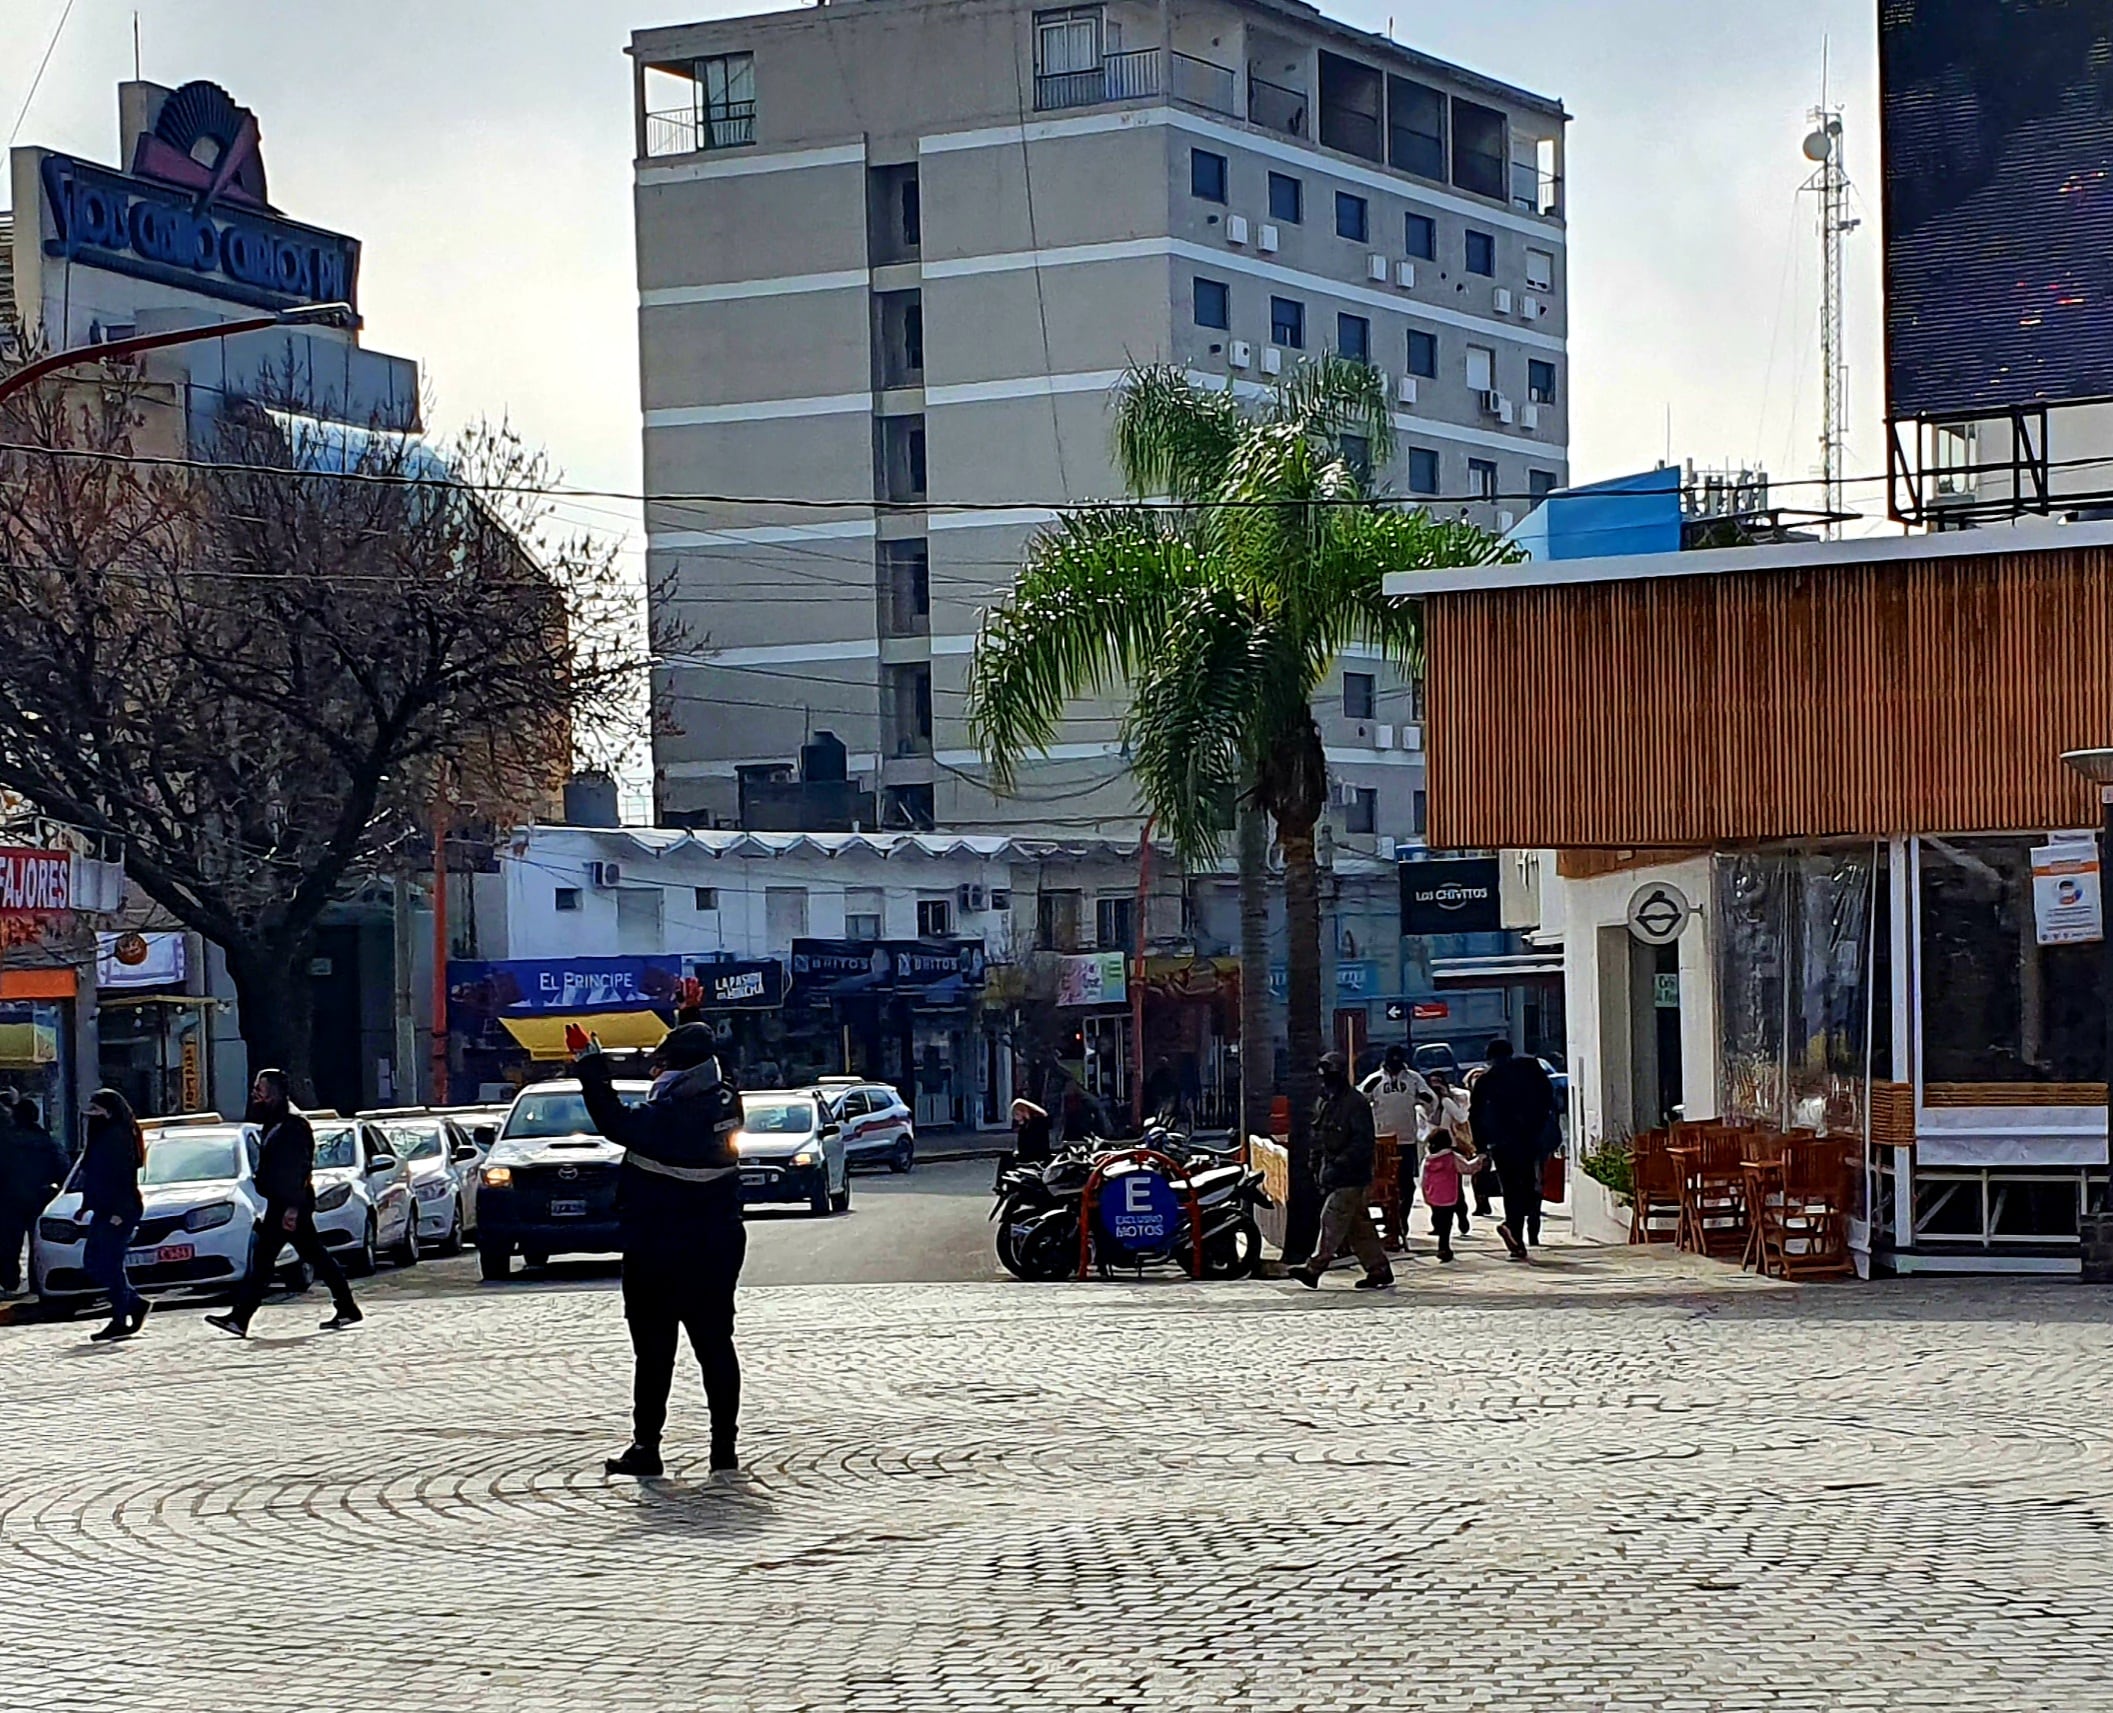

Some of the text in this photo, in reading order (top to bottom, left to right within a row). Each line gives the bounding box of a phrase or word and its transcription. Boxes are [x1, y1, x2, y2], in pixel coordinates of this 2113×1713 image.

[1415, 890, 1433, 901] LOS
[540, 971, 633, 990] EL PRINCIPE
[1125, 1177, 1152, 1212] E
[1116, 1224, 1164, 1237] MOTOS
